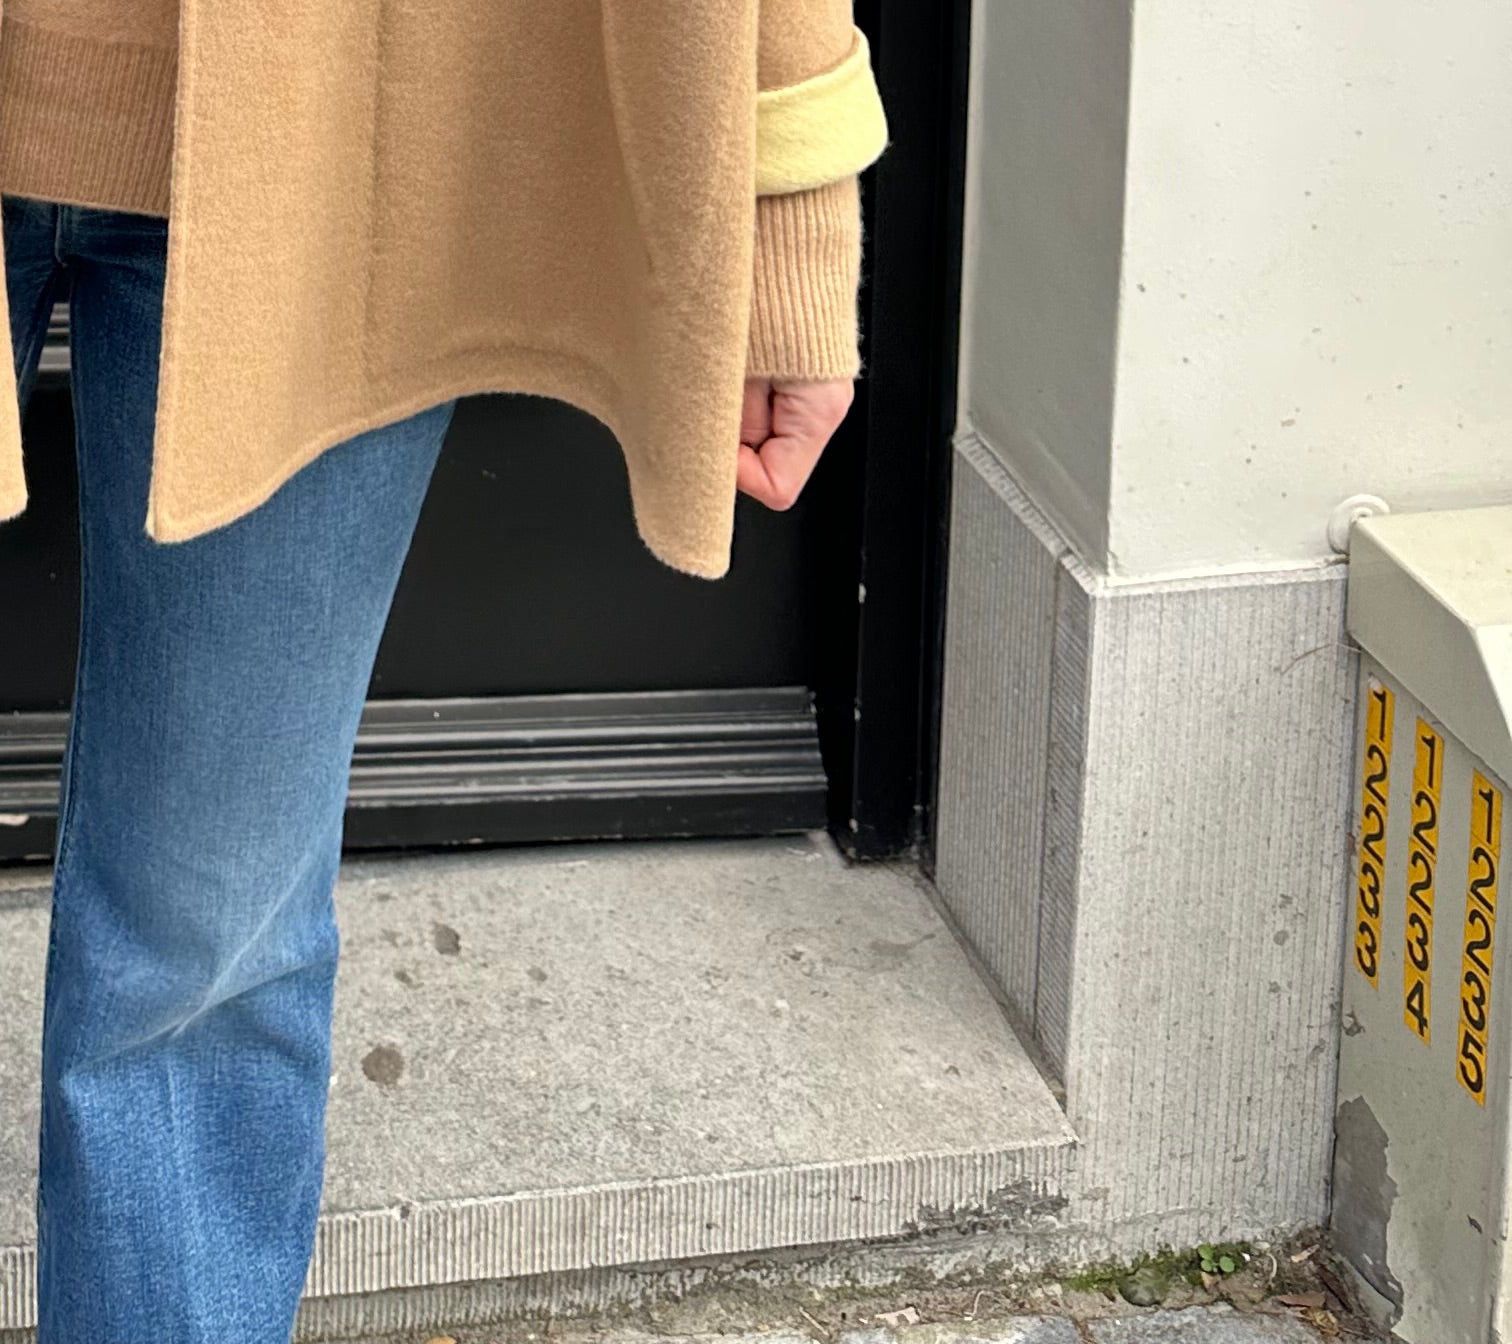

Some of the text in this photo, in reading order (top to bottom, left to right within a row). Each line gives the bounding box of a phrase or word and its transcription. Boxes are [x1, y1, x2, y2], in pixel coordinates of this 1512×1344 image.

[1356, 690, 1388, 978] 12233
[1406, 734, 1437, 1037] 12234
[1459, 788, 1496, 1094] 12235
